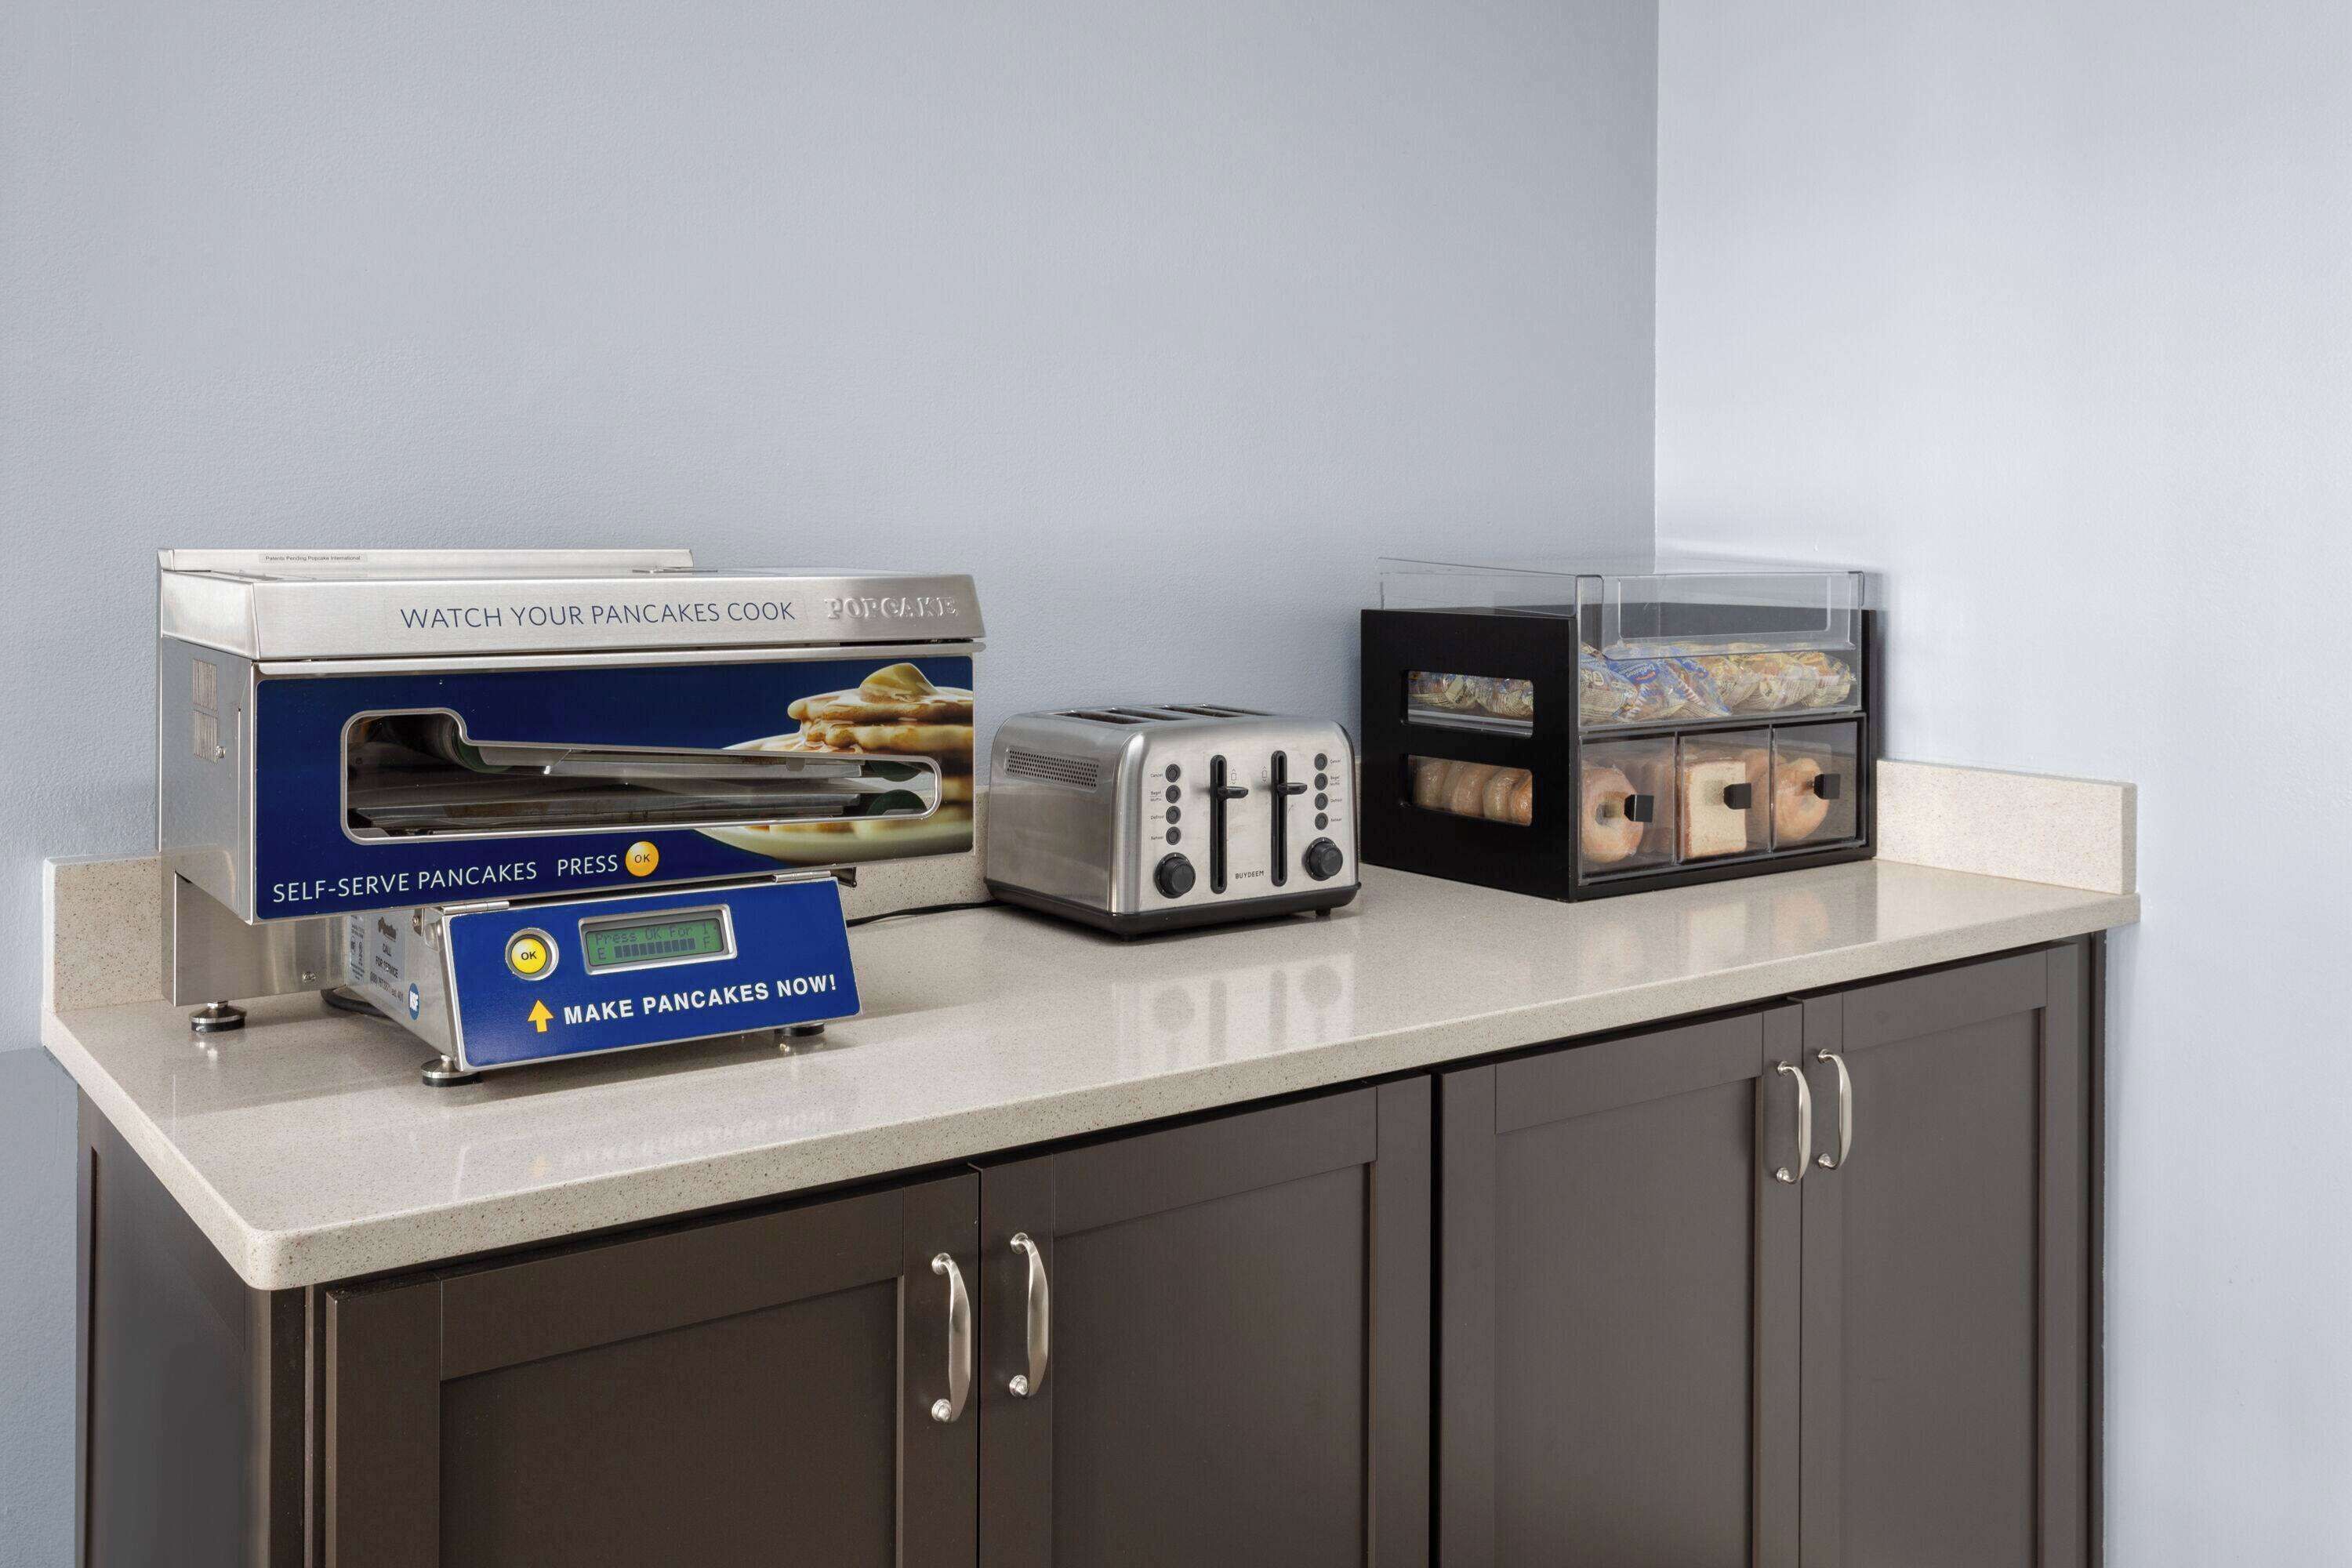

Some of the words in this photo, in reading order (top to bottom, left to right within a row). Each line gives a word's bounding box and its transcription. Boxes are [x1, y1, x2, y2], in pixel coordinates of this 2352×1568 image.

[401, 608, 502, 629] WATCH
[510, 606, 584, 626] YOUR
[592, 603, 720, 625] PANCAKES
[728, 601, 797, 622] COOK
[824, 596, 960, 620] POPCAKE
[273, 873, 409, 902] SELF-SERVE
[419, 862, 537, 889] PANCAKES
[557, 855, 618, 877] PRESS
[633, 854, 651, 863] OK
[1235, 870, 1265, 879] BUYDEEM
[595, 931, 638, 945] Press
[645, 927, 662, 940] OK
[521, 950, 538, 960] OK
[597, 948, 607, 960] E
[409, 990, 419, 1012] NSF
[564, 1000, 634, 1025] MAKE
[643, 982, 769, 1015] PANCAKES
[777, 974, 837, 998] NOW!
